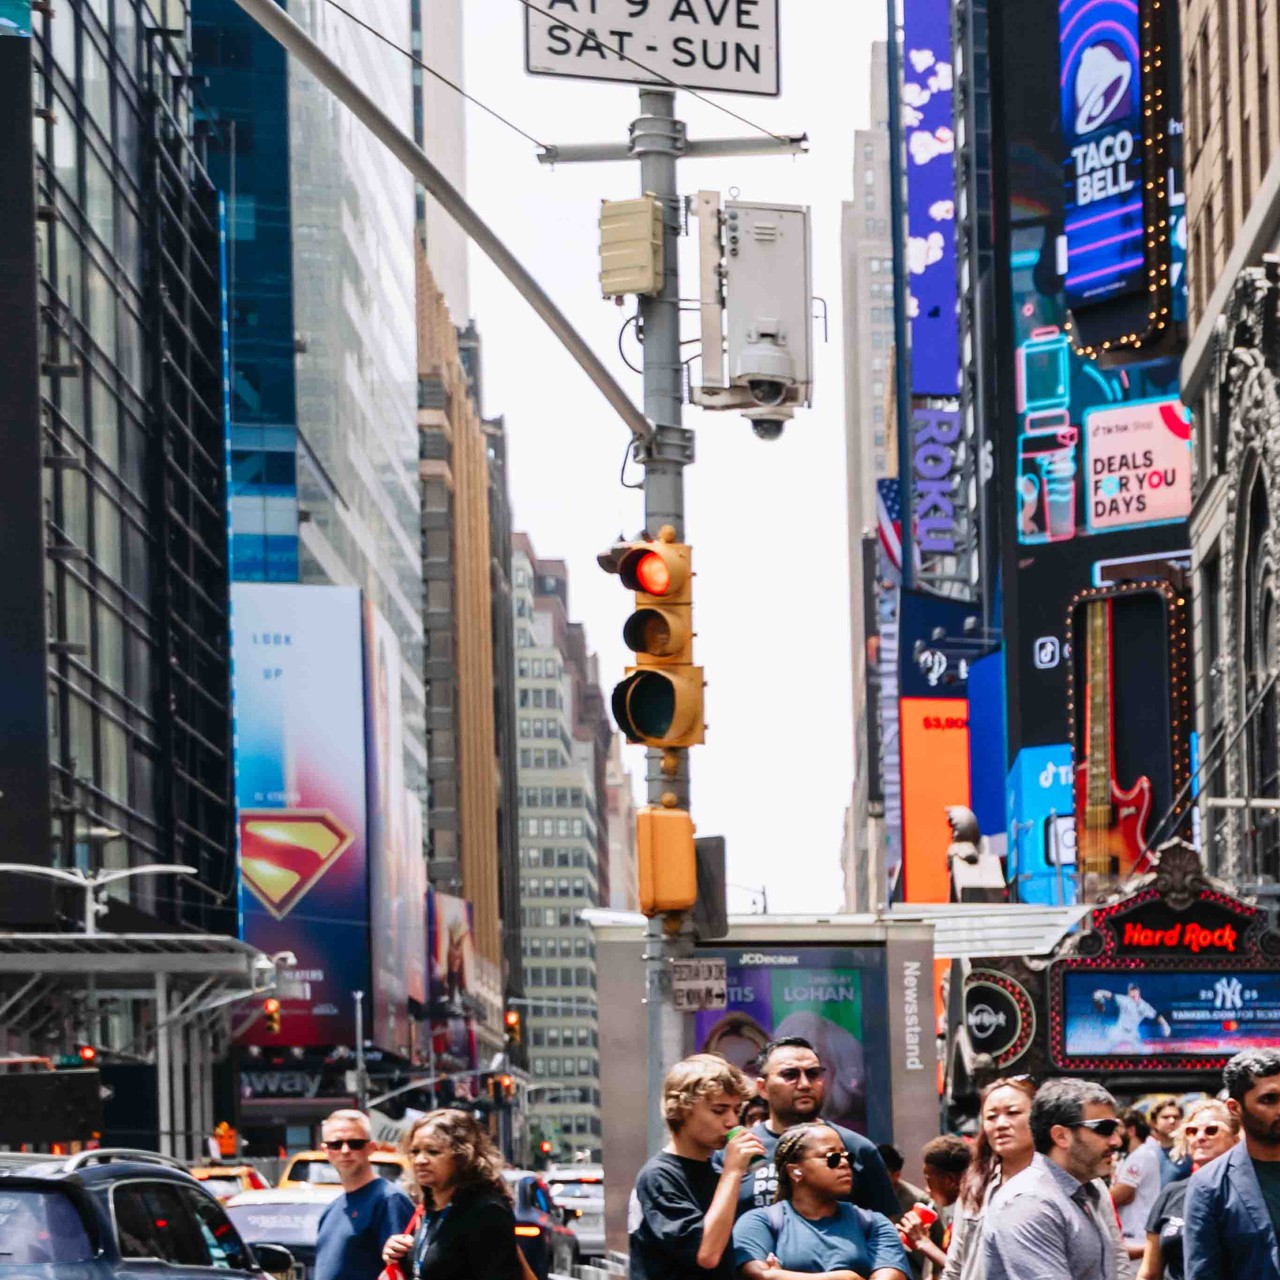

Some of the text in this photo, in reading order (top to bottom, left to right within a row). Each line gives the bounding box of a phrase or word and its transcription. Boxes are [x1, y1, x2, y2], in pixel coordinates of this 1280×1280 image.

[669, 0, 760, 30] AVE
[546, 25, 633, 61] SAT
[672, 36, 761, 74] SUN
[1071, 130, 1134, 176] TACO
[1076, 163, 1134, 206] BELL
[1093, 450, 1154, 475] DEALS
[912, 408, 961, 551] ROKU
[1094, 468, 1176, 496] FOR YOU
[1094, 494, 1147, 518] DAYS
[1123, 922, 1237, 953] Hard Rock
[739, 953, 799, 965] JCDecaux
[728, 986, 755, 1002] TIS
[784, 986, 854, 1002] LOHAN
[903, 961, 924, 1070] Newsstand
[240, 1070, 322, 1098] way
